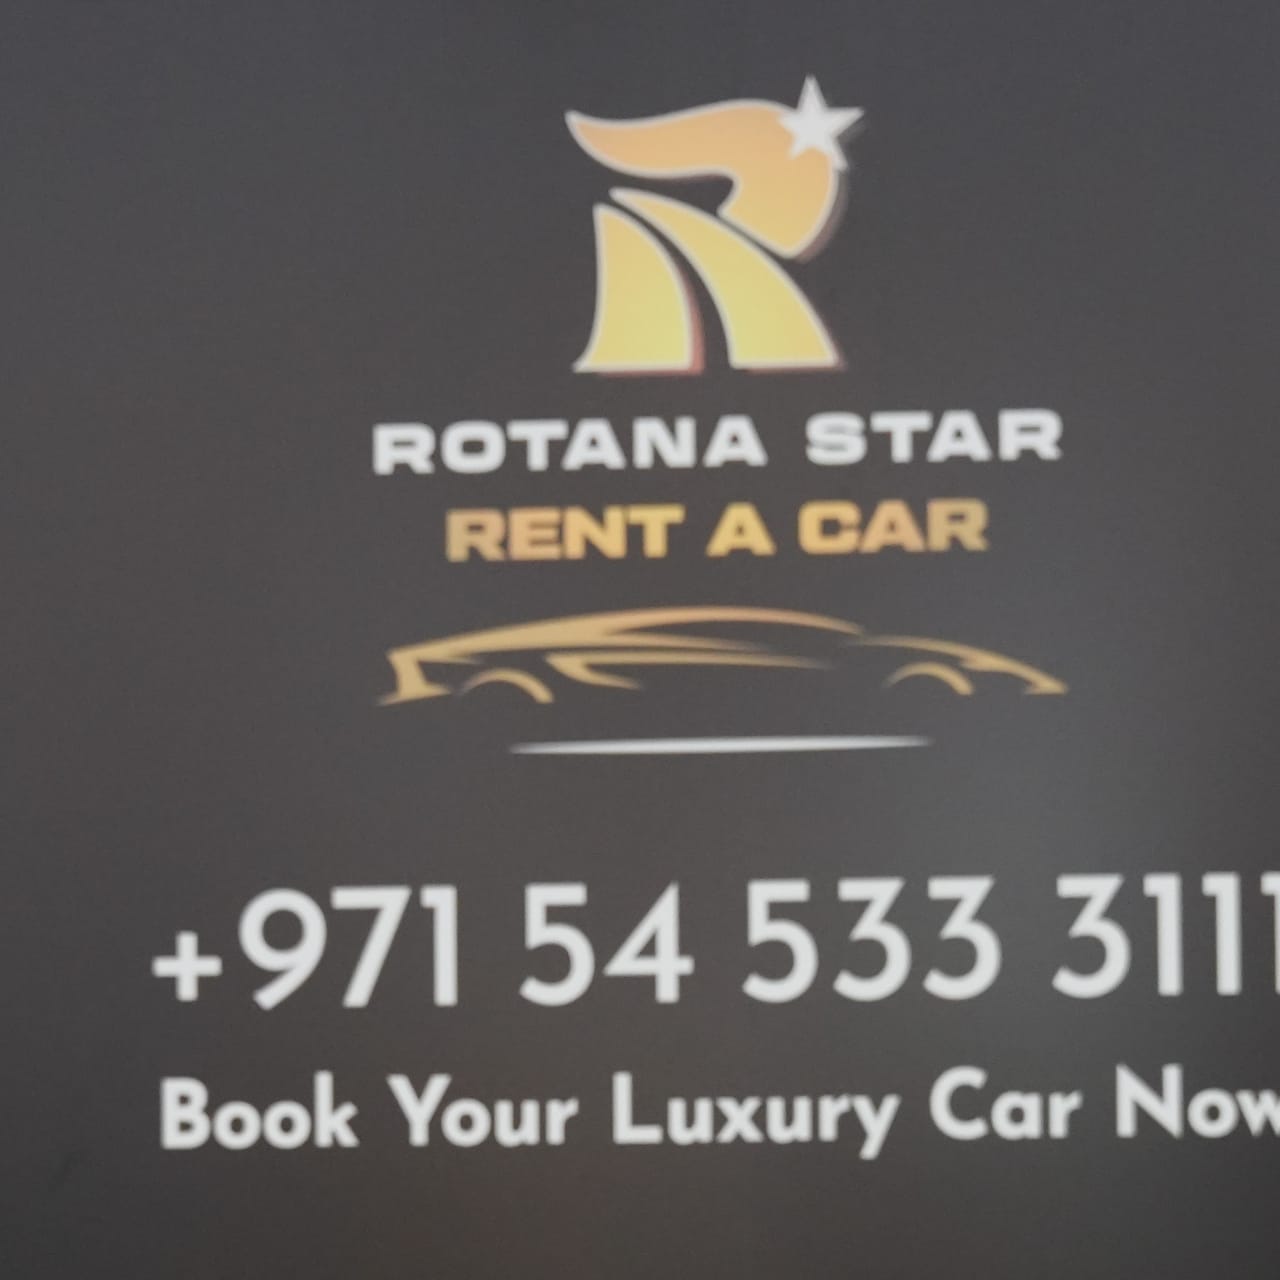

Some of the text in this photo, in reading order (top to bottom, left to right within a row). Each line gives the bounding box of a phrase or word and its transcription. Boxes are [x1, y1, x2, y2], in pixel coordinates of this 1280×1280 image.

[373, 408, 1062, 475] ROTANA STAR
[446, 498, 988, 562] RENT A CAR
[153, 882, 458, 1010] +971
[520, 883, 695, 1006] 54
[742, 875, 1001, 1003] 533
[161, 1070, 358, 1149] Book
[388, 1074, 579, 1147] Your
[612, 1071, 900, 1160] Luxury
[930, 1066, 1082, 1140] Car
